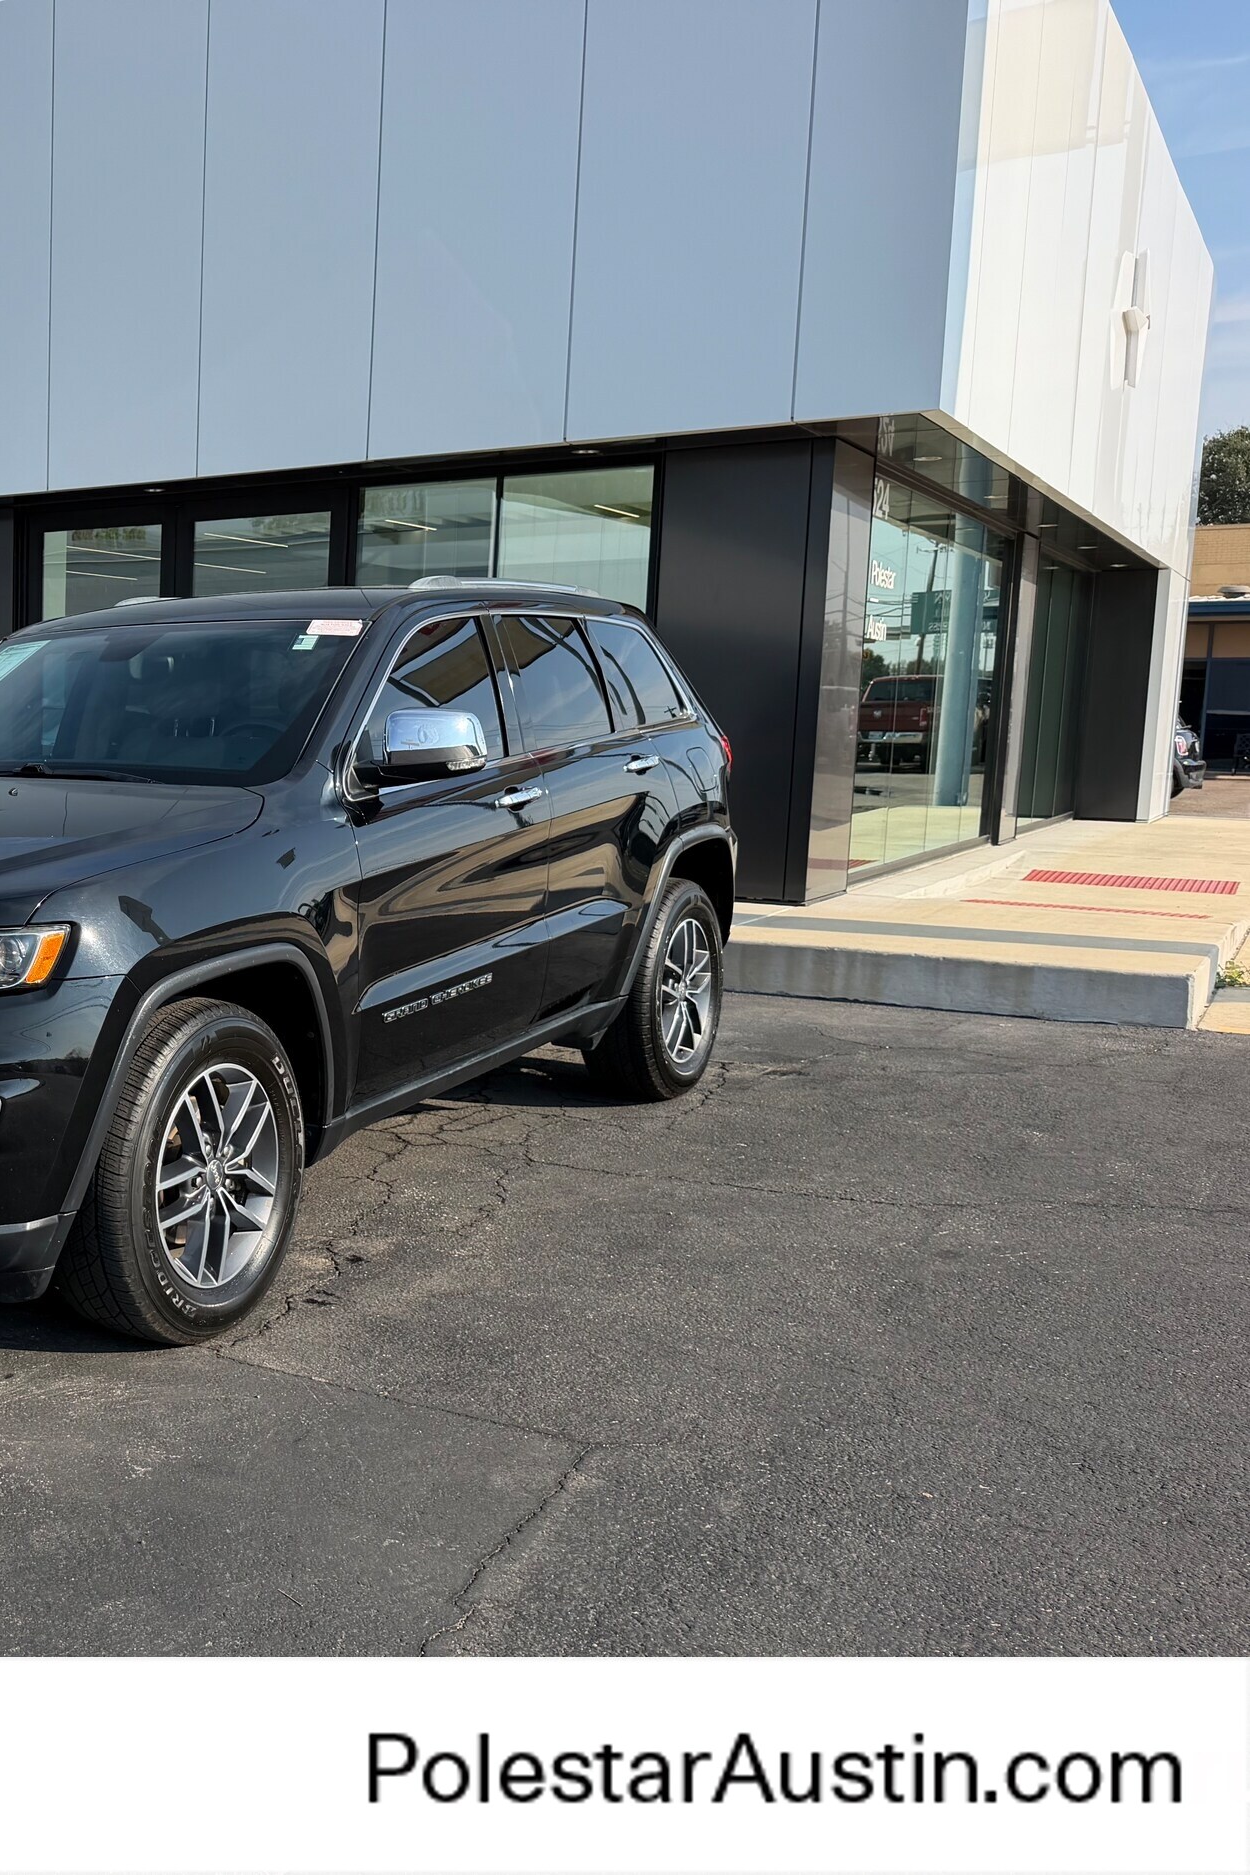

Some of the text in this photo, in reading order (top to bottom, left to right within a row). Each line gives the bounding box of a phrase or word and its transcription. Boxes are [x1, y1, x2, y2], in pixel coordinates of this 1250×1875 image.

[871, 560, 897, 589] Polestar
[866, 614, 887, 641] Austin
[382, 972, 493, 1024] GRAND CHEROKEE
